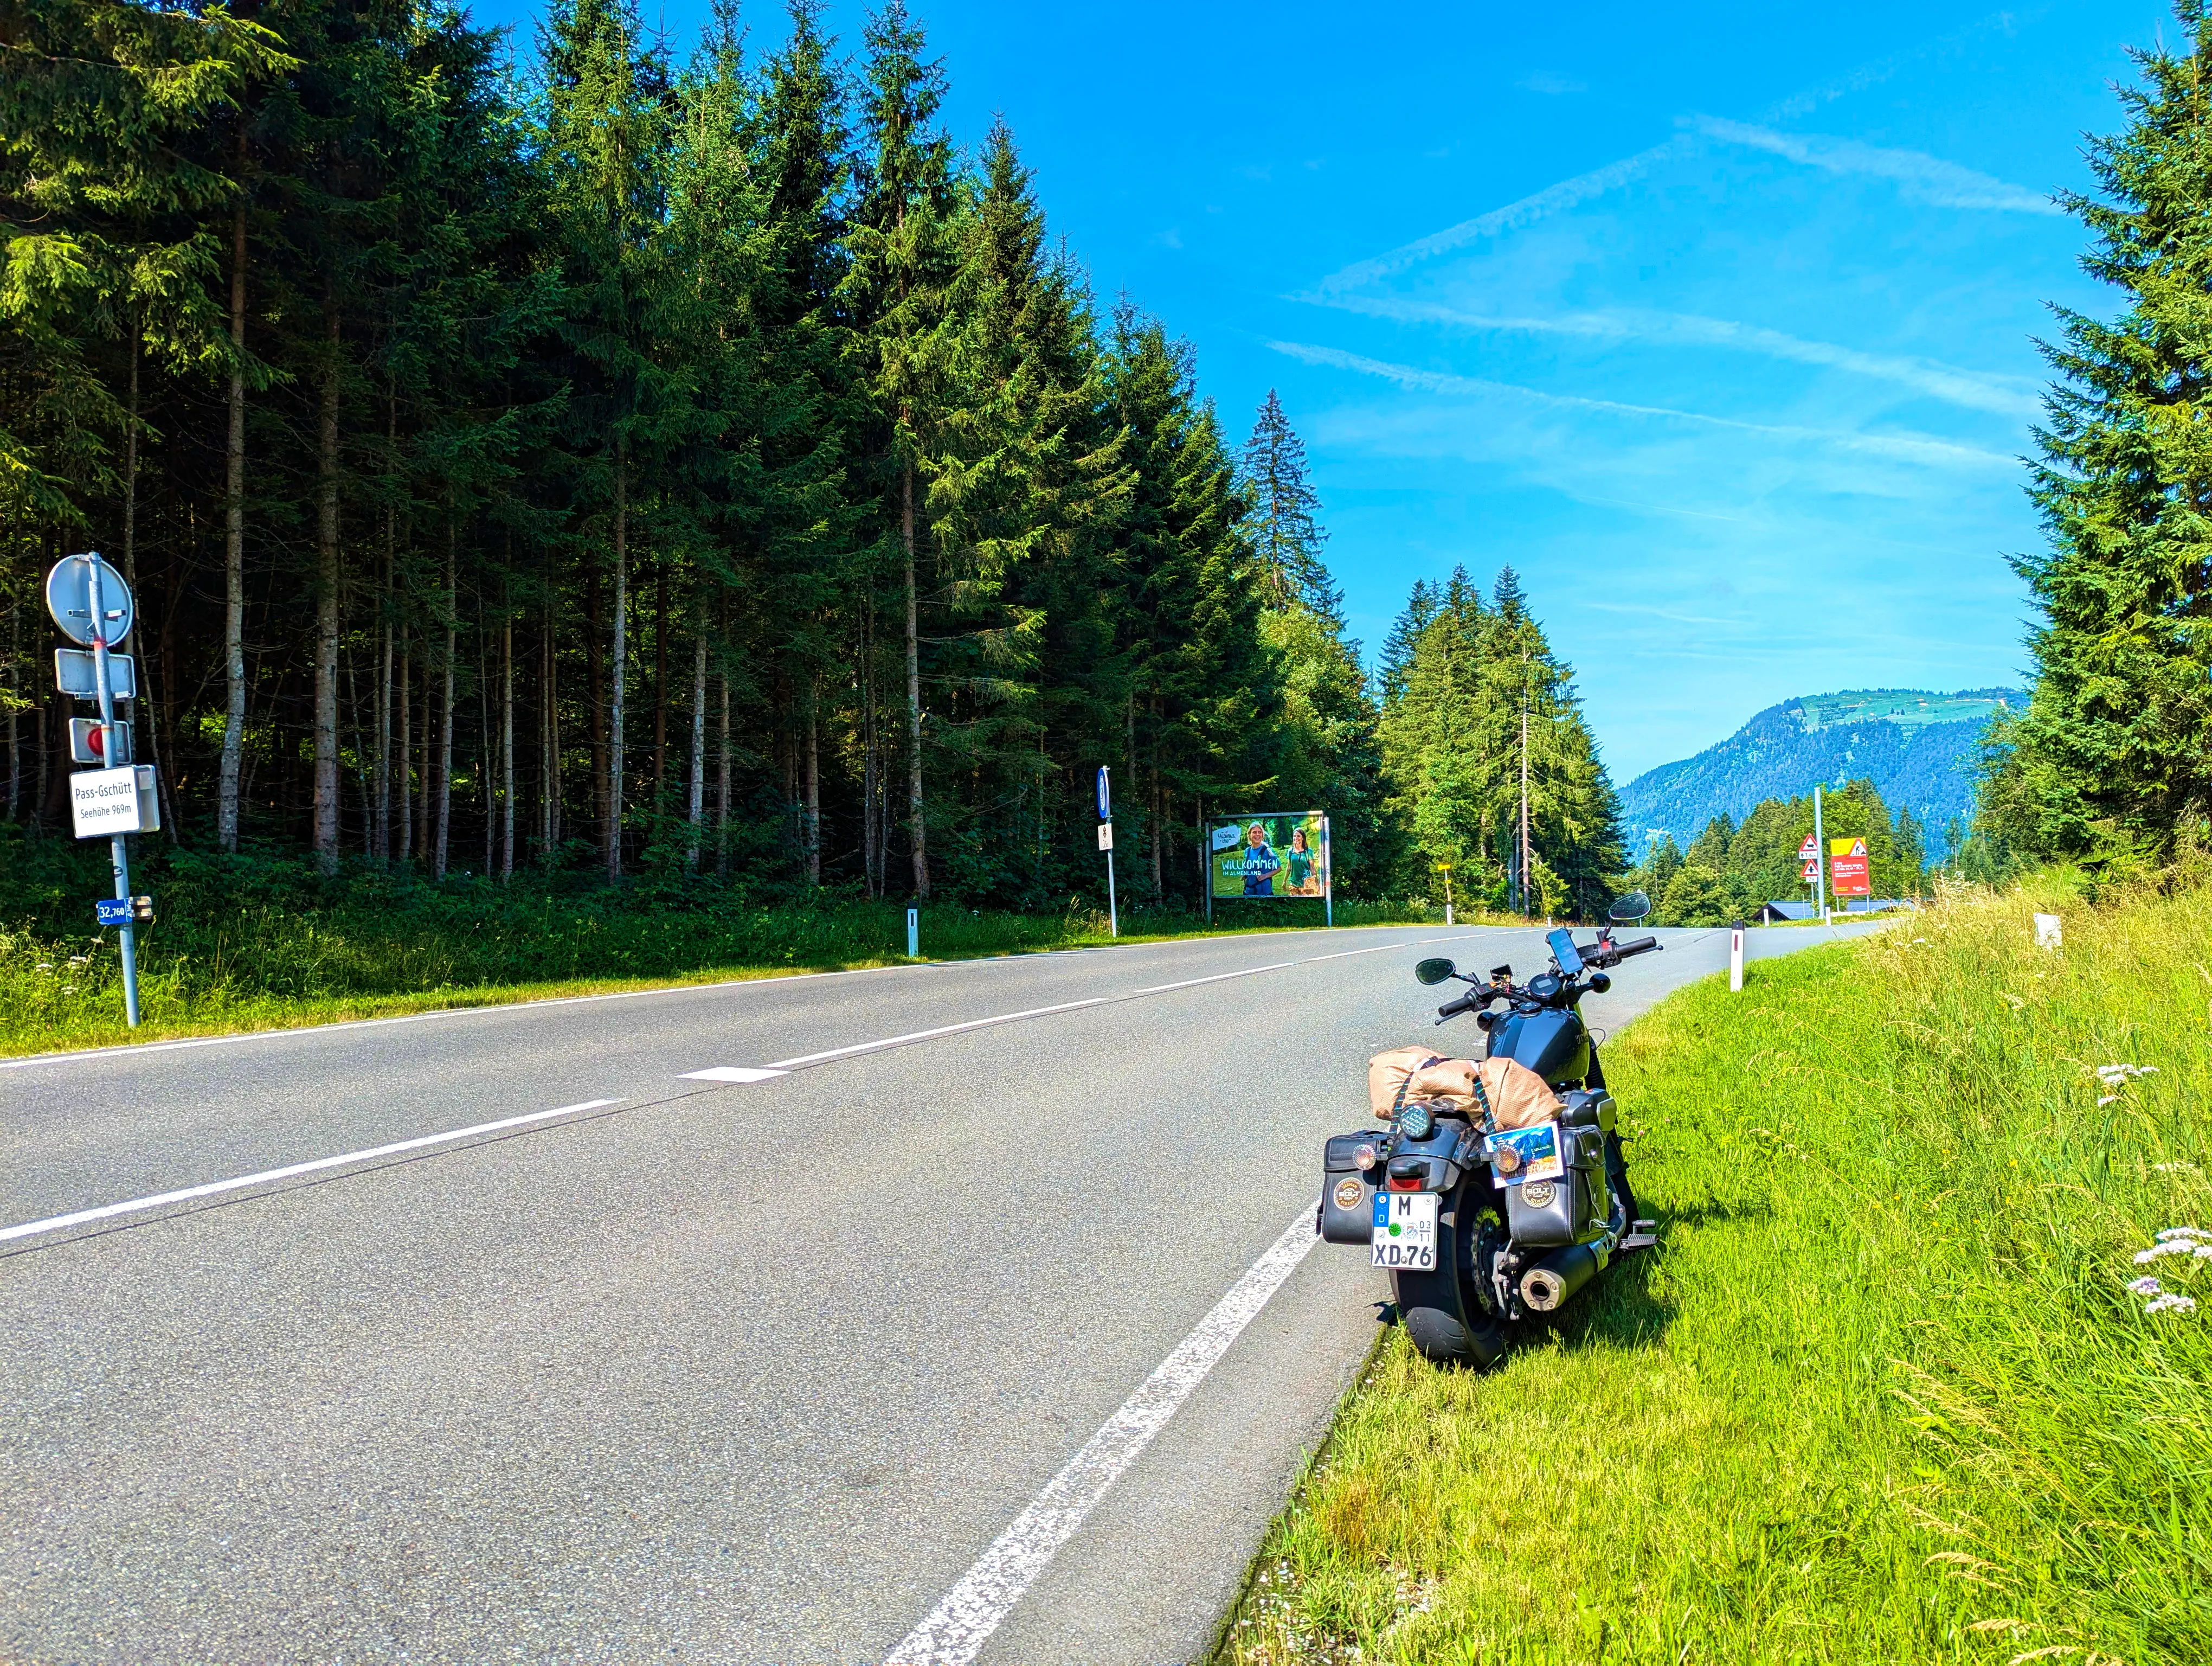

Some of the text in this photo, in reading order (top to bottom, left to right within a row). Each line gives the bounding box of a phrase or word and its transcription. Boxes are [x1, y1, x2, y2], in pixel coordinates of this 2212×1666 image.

[75, 781, 132, 800] Pass-Gschütt
[80, 804, 131, 818] Seehöhe 969m
[99, 906, 125, 918] 32,760
[1398, 1195, 1411, 1215] M
[1379, 1214, 1385, 1223] D
[1419, 1220, 1431, 1229] 03
[1419, 1233, 1430, 1241] 11
[1374, 1244, 1431, 1266] XD 76
